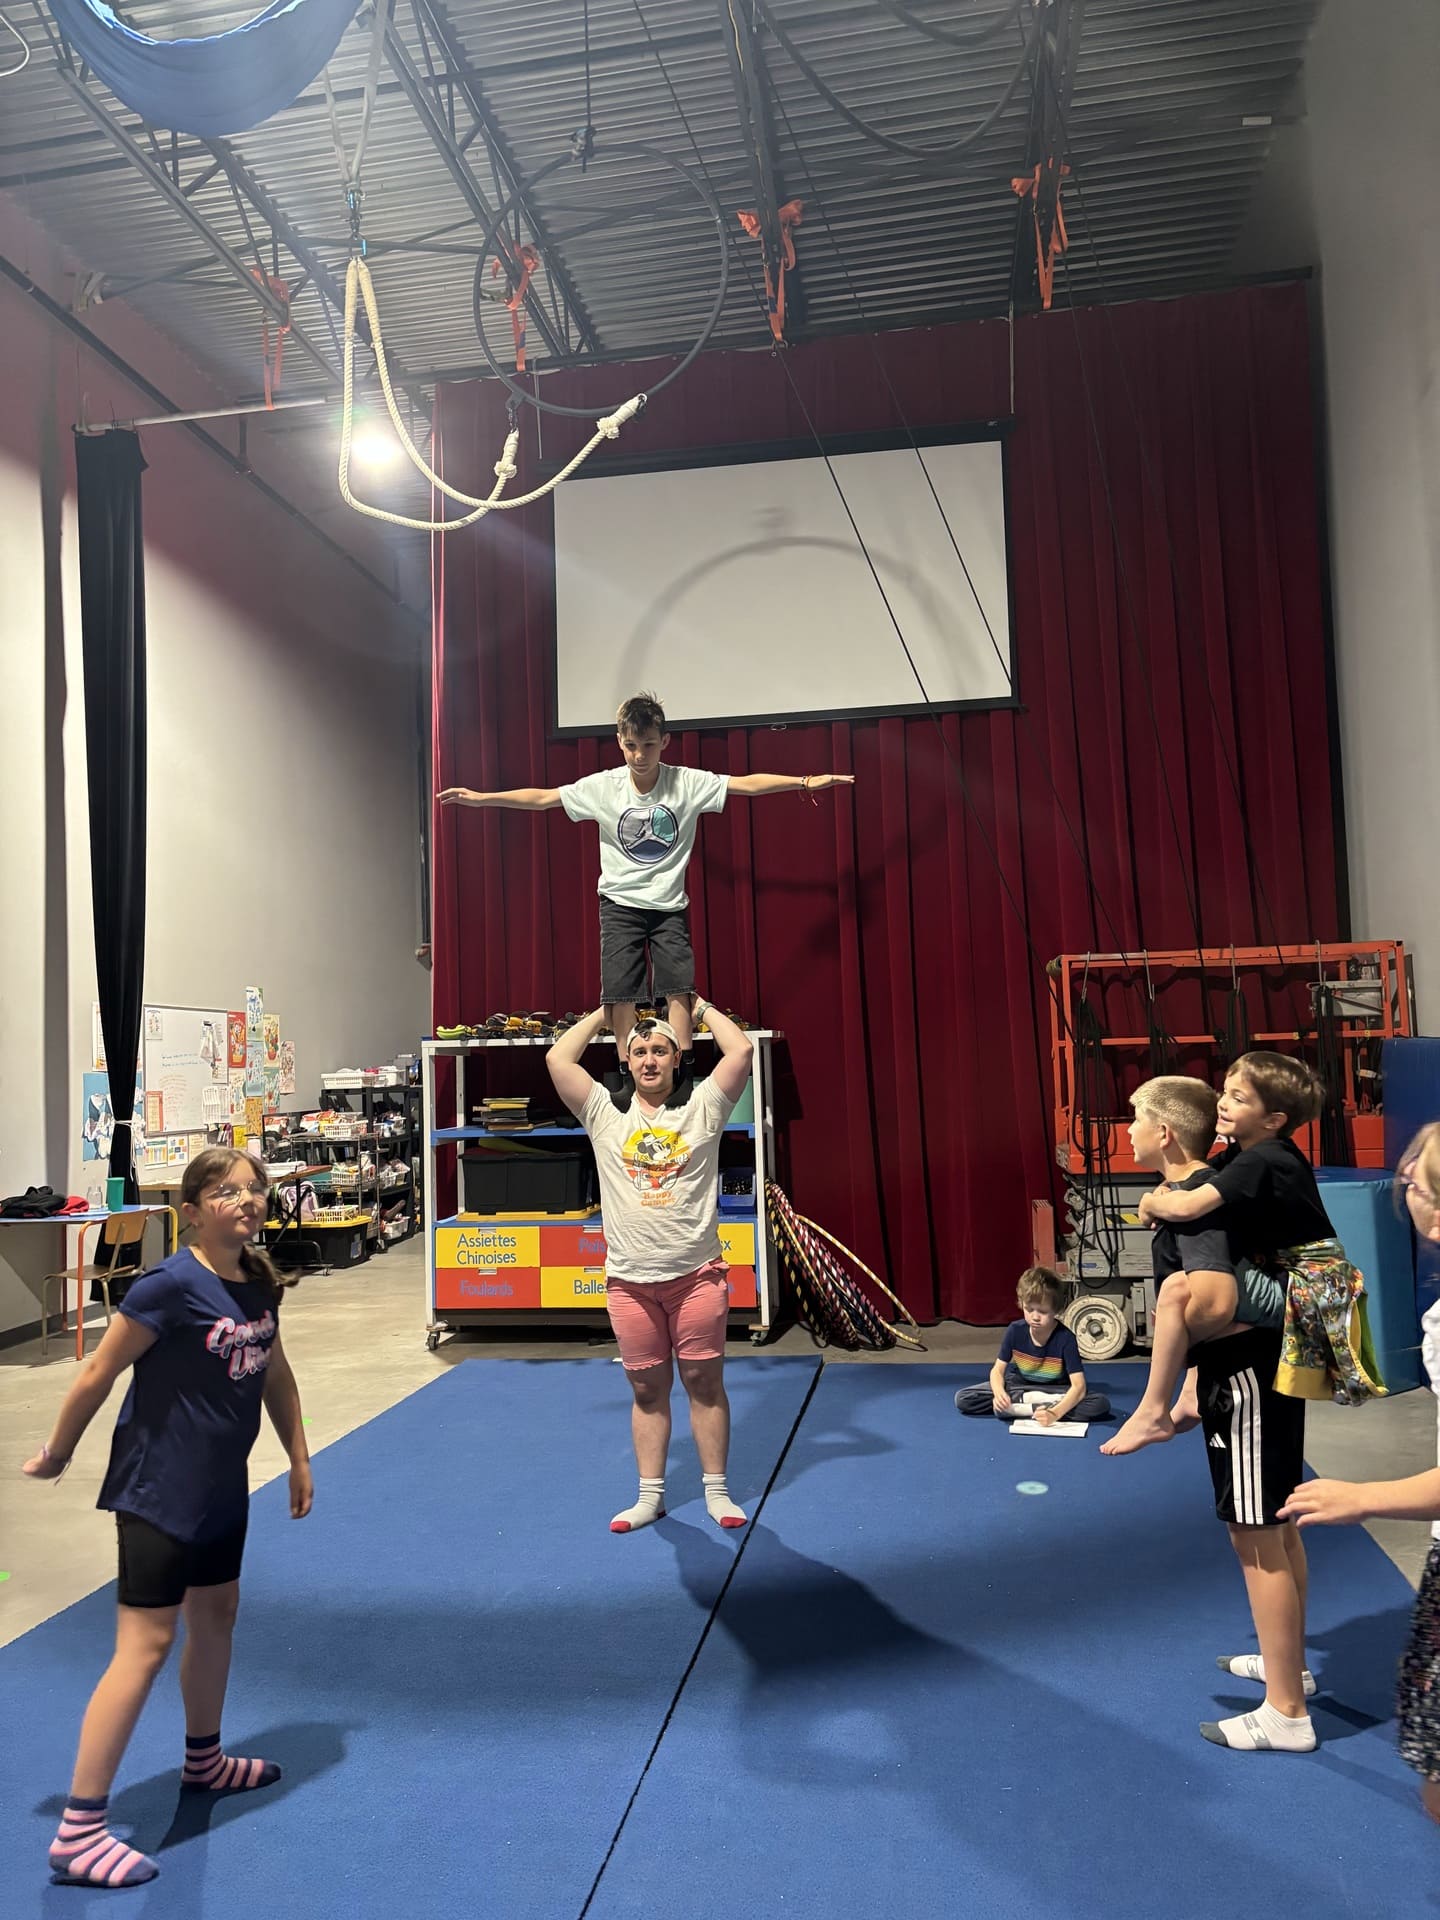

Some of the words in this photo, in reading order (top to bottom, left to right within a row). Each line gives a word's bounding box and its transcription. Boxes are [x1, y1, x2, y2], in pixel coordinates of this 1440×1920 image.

[457, 1233, 517, 1248] Assiettes
[457, 1250, 517, 1265] Chinoises
[459, 1279, 514, 1297] Foulards
[206, 1310, 274, 1359] Good
